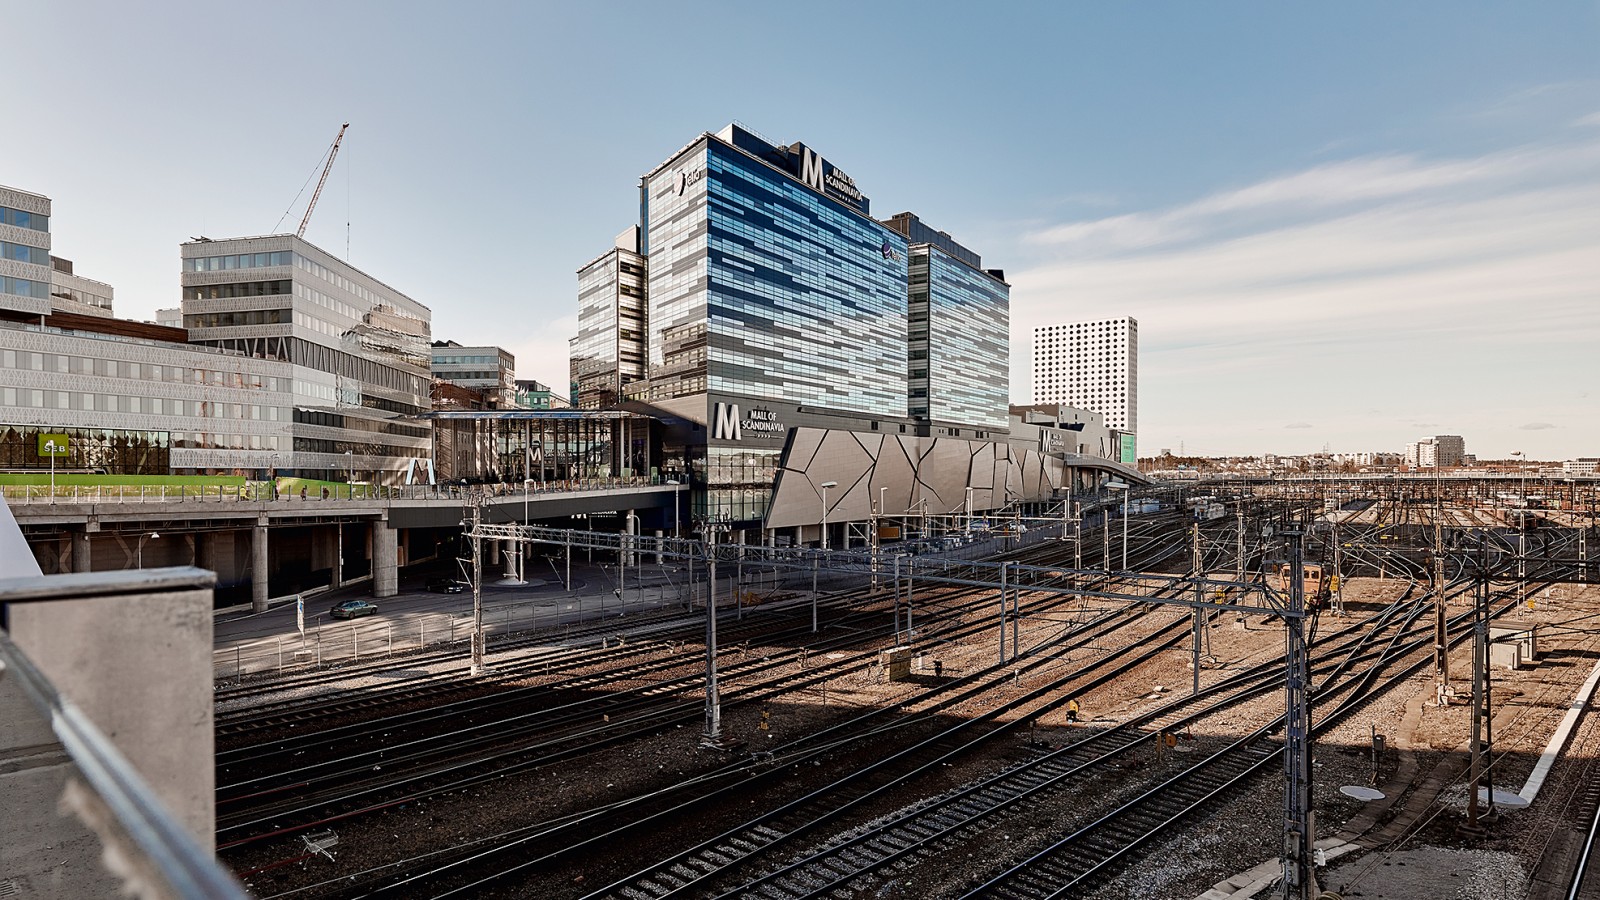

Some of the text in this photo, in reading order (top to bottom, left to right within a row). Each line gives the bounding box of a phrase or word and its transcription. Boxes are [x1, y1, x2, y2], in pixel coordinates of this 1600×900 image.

[802, 146, 825, 193] M
[833, 167, 848, 183] MALL
[825, 174, 863, 202] SCANDINAVIA
[715, 402, 741, 440] M
[742, 420, 785, 432] SCANDINAVIA
[750, 410, 777, 421] MALL OF
